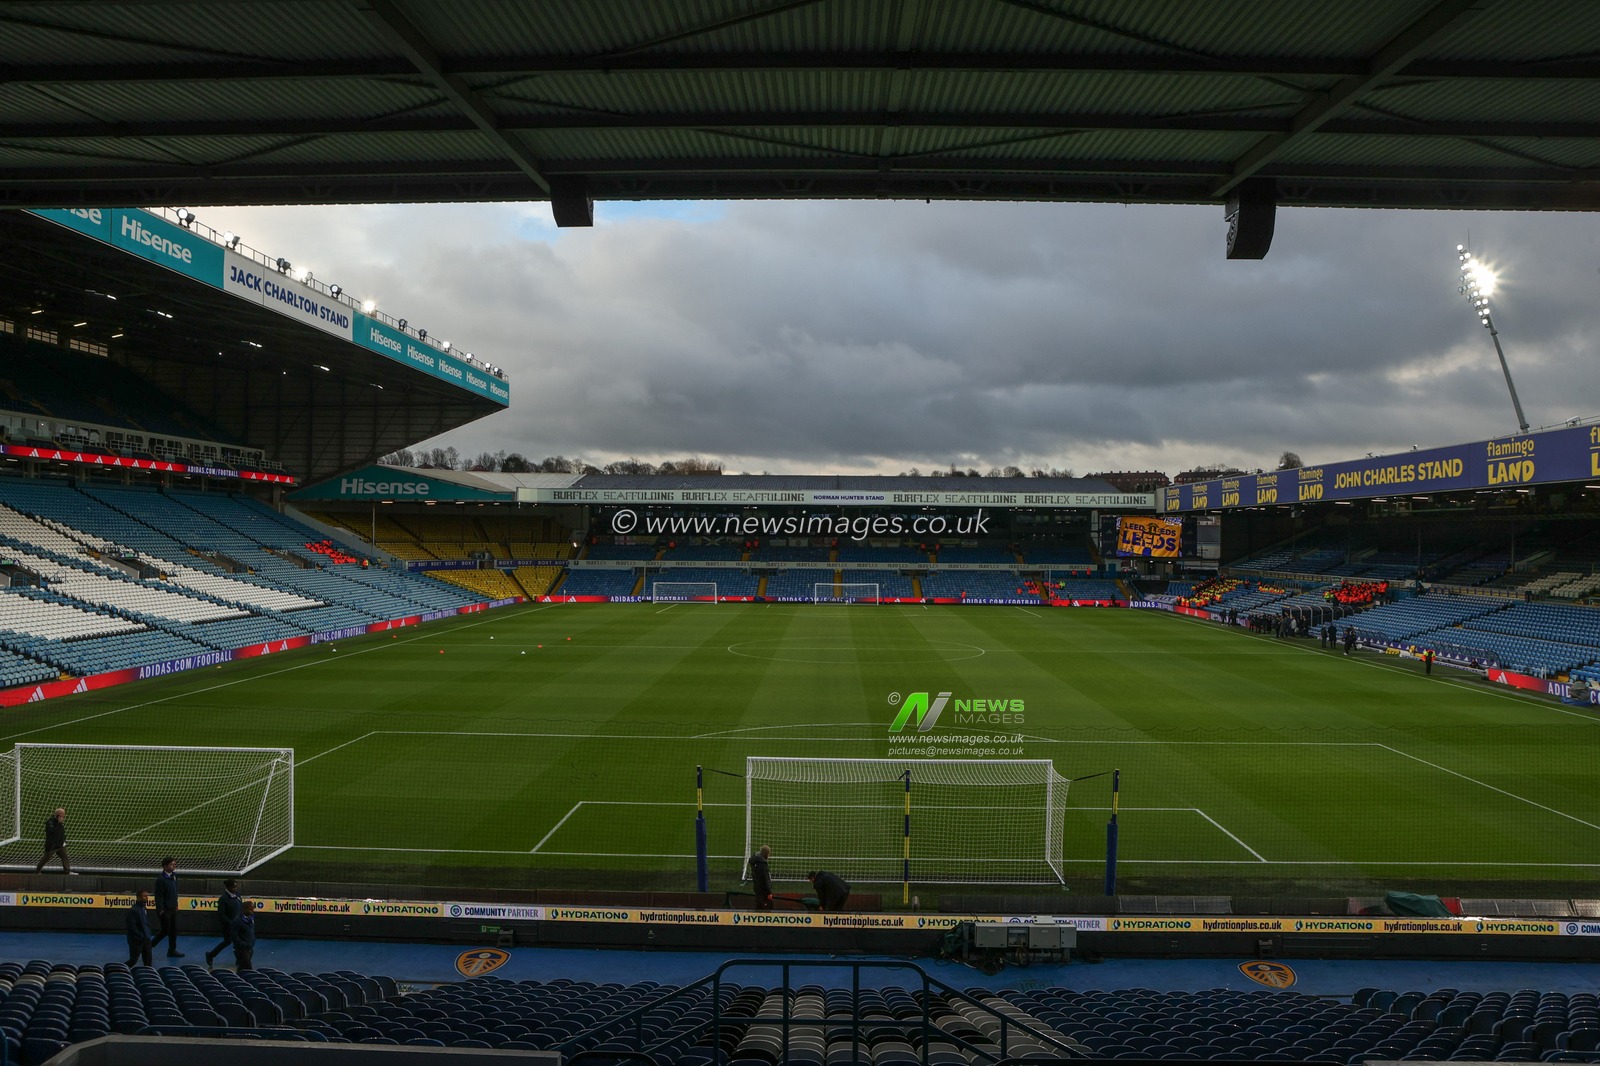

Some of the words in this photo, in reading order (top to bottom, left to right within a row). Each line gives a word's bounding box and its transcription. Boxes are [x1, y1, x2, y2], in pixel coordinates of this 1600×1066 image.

[121, 215, 192, 264] Hisense
[230, 265, 262, 293] JACK
[264, 280, 318, 316] CHARLTON
[320, 305, 349, 329] STAND
[370, 327, 402, 353] Hisense
[407, 344, 434, 368] Hisense
[438, 358, 462, 380] Hisense
[466, 371, 487, 390] Hisense
[490, 381, 508, 399] Hisense
[1487, 438, 1535, 457] flamingo
[187, 465, 239, 478] ADIDAS.COM/FOOTBALL
[1298, 467, 1323, 482] flamingo
[1334, 470, 1362, 489] JOHN
[1363, 464, 1415, 486] CHARLES
[1418, 458, 1463, 481] STAND
[1488, 459, 1535, 485] LAND
[341, 478, 429, 495] Hisense
[1299, 484, 1323, 500] LAND
[553, 490, 598, 500] BURFLEX
[603, 491, 674, 501] SCAFFOLDING
[681, 491, 727, 501] BURFLEX
[733, 492, 805, 502] SCAFFOLDING
[893, 493, 939, 503] BURFLEX
[945, 494, 1017, 504] SCAFFOLDING
[1024, 495, 1070, 504] BURFLEX
[1075, 495, 1147, 505] SCAFFOLDING
[1222, 492, 1239, 507] LAND
[1257, 488, 1277, 504] LAND
[311, 625, 366, 644] ADIDAS.COM/FOOTBALL
[139, 650, 233, 679] ADIDAS.COM/FOOTBALL
[274, 900, 350, 913] hydrationplus.co.uk
[464, 906, 506, 917] COMMUNITY
[507, 907, 539, 918] PARTNER
[640, 911, 720, 923] hydrationplus.co.uk
[1202, 919, 1282, 932] hydrationplus.co.uk
[1384, 920, 1463, 933] hydrationplus.co.uk
